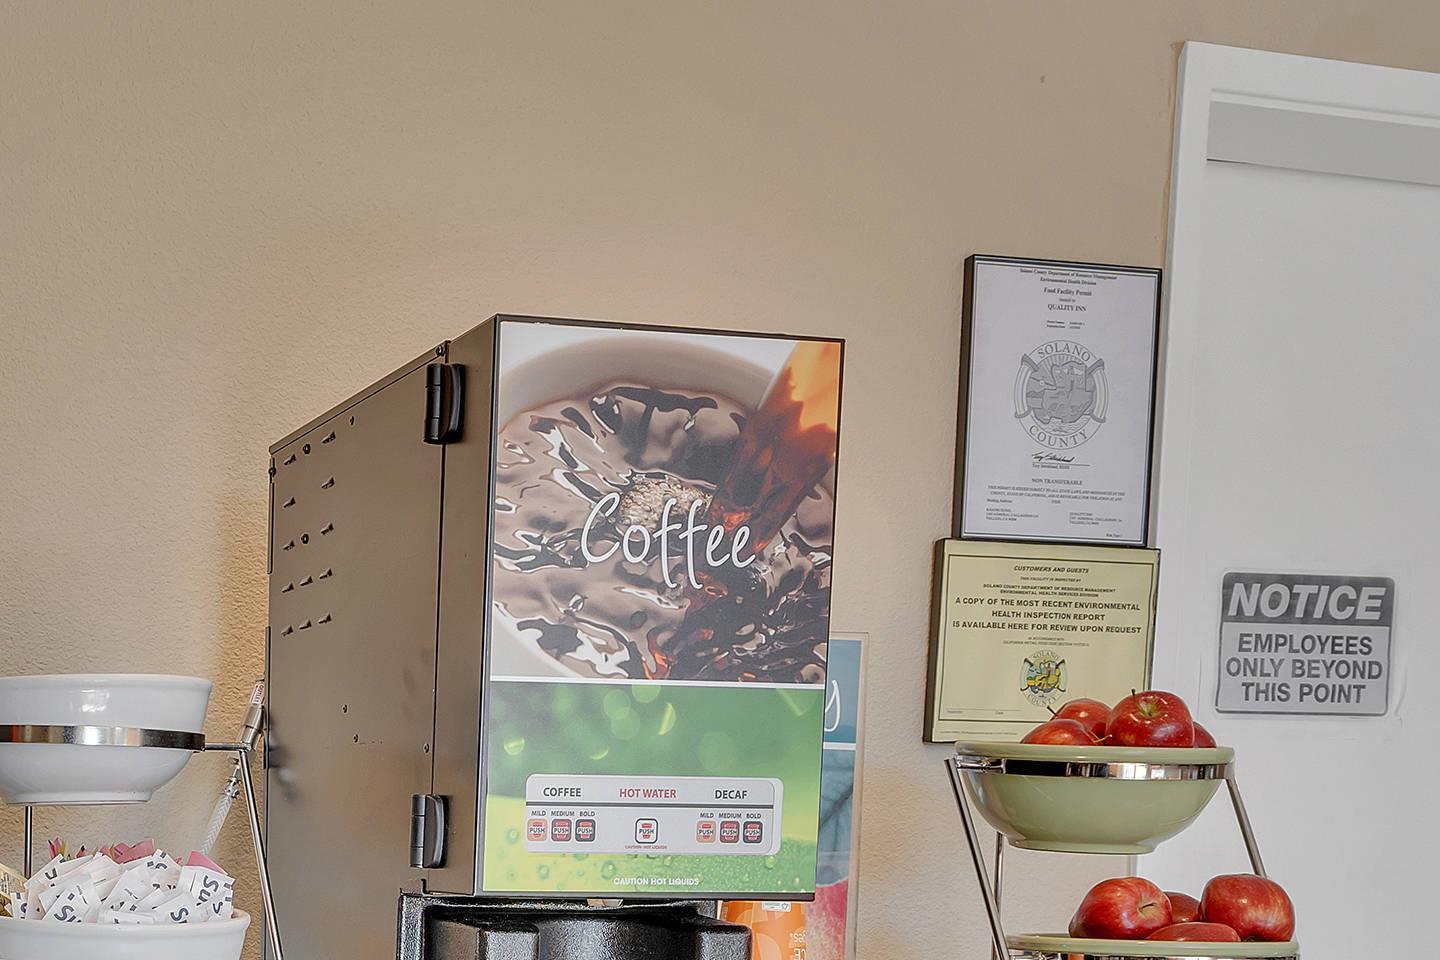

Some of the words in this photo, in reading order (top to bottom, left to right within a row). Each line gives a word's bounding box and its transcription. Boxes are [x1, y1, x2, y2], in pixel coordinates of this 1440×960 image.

[1047, 304, 1074, 312] QUALITY
[1038, 343, 1091, 362] SOLANO
[1029, 425, 1087, 447] COUNTY
[581, 492, 756, 589] Coffee
[1016, 599, 1039, 607] MOST
[1074, 601, 1141, 611] ENVIRONMENTAL
[1228, 583, 1387, 620] NOTICE
[992, 610, 1021, 618] HEALTH
[1023, 611, 1071, 620] INSPECTION
[1073, 613, 1106, 621] REPORT
[961, 621, 1006, 629] AVAILABLE
[1031, 623, 1048, 631] FOR
[1050, 624, 1078, 632] REVIEW
[1105, 626, 1142, 634] REQUEST
[1238, 633, 1373, 655] EMPLOYEES
[1226, 656, 1285, 678] ONLY
[1291, 658, 1383, 680] BEYOND
[1241, 682, 1291, 702] THIS
[1299, 683, 1366, 703] POINT
[543, 787, 582, 798] COFFEE
[619, 788, 641, 798] HOT
[642, 788, 677, 799] WATER
[714, 789, 748, 800] DECAF
[638, 827, 655, 835] PUSH
[613, 877, 650, 886] CAUTION
[651, 877, 667, 886] HOT
[668, 877, 699, 886] LIQUIDS
